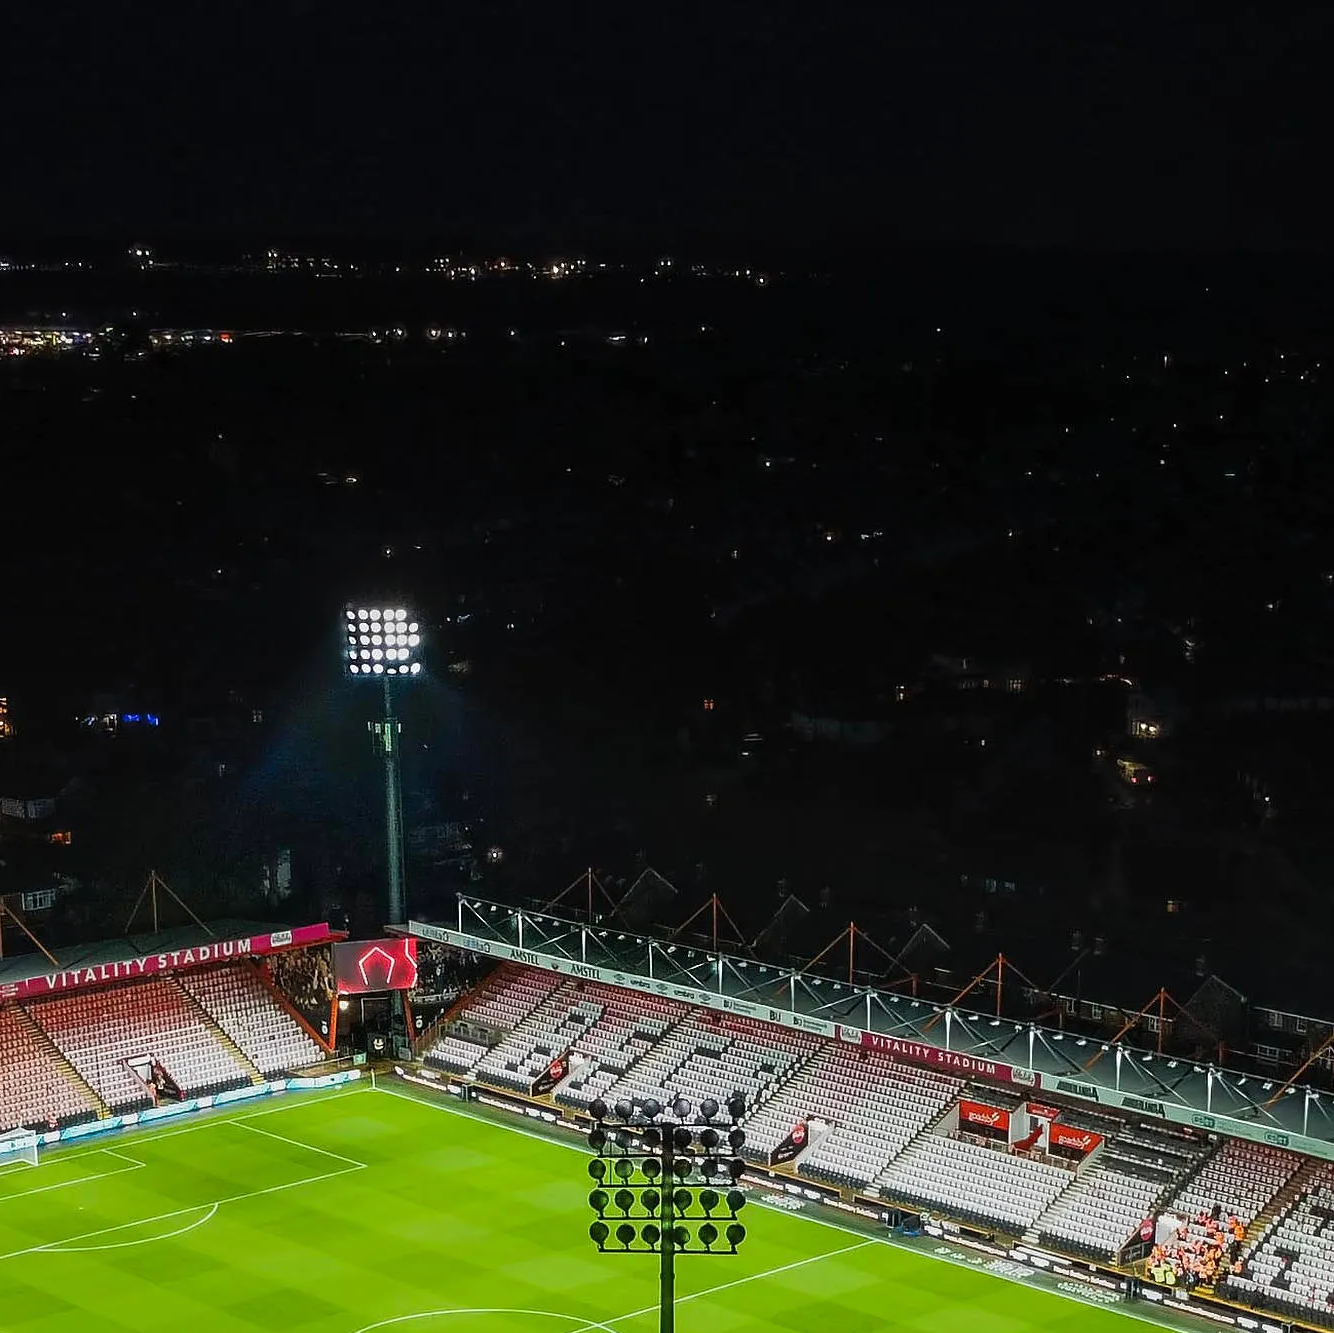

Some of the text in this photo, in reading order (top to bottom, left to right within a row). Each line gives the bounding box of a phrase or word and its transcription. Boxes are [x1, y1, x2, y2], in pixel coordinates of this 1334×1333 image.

[46, 939, 251, 989] VITALITY STADIUM
[510, 950, 539, 966] AMSTEL
[570, 963, 601, 980] AMSTEL
[870, 1035, 930, 1058] VITALITY
[938, 1052, 996, 1075] STADIUM
